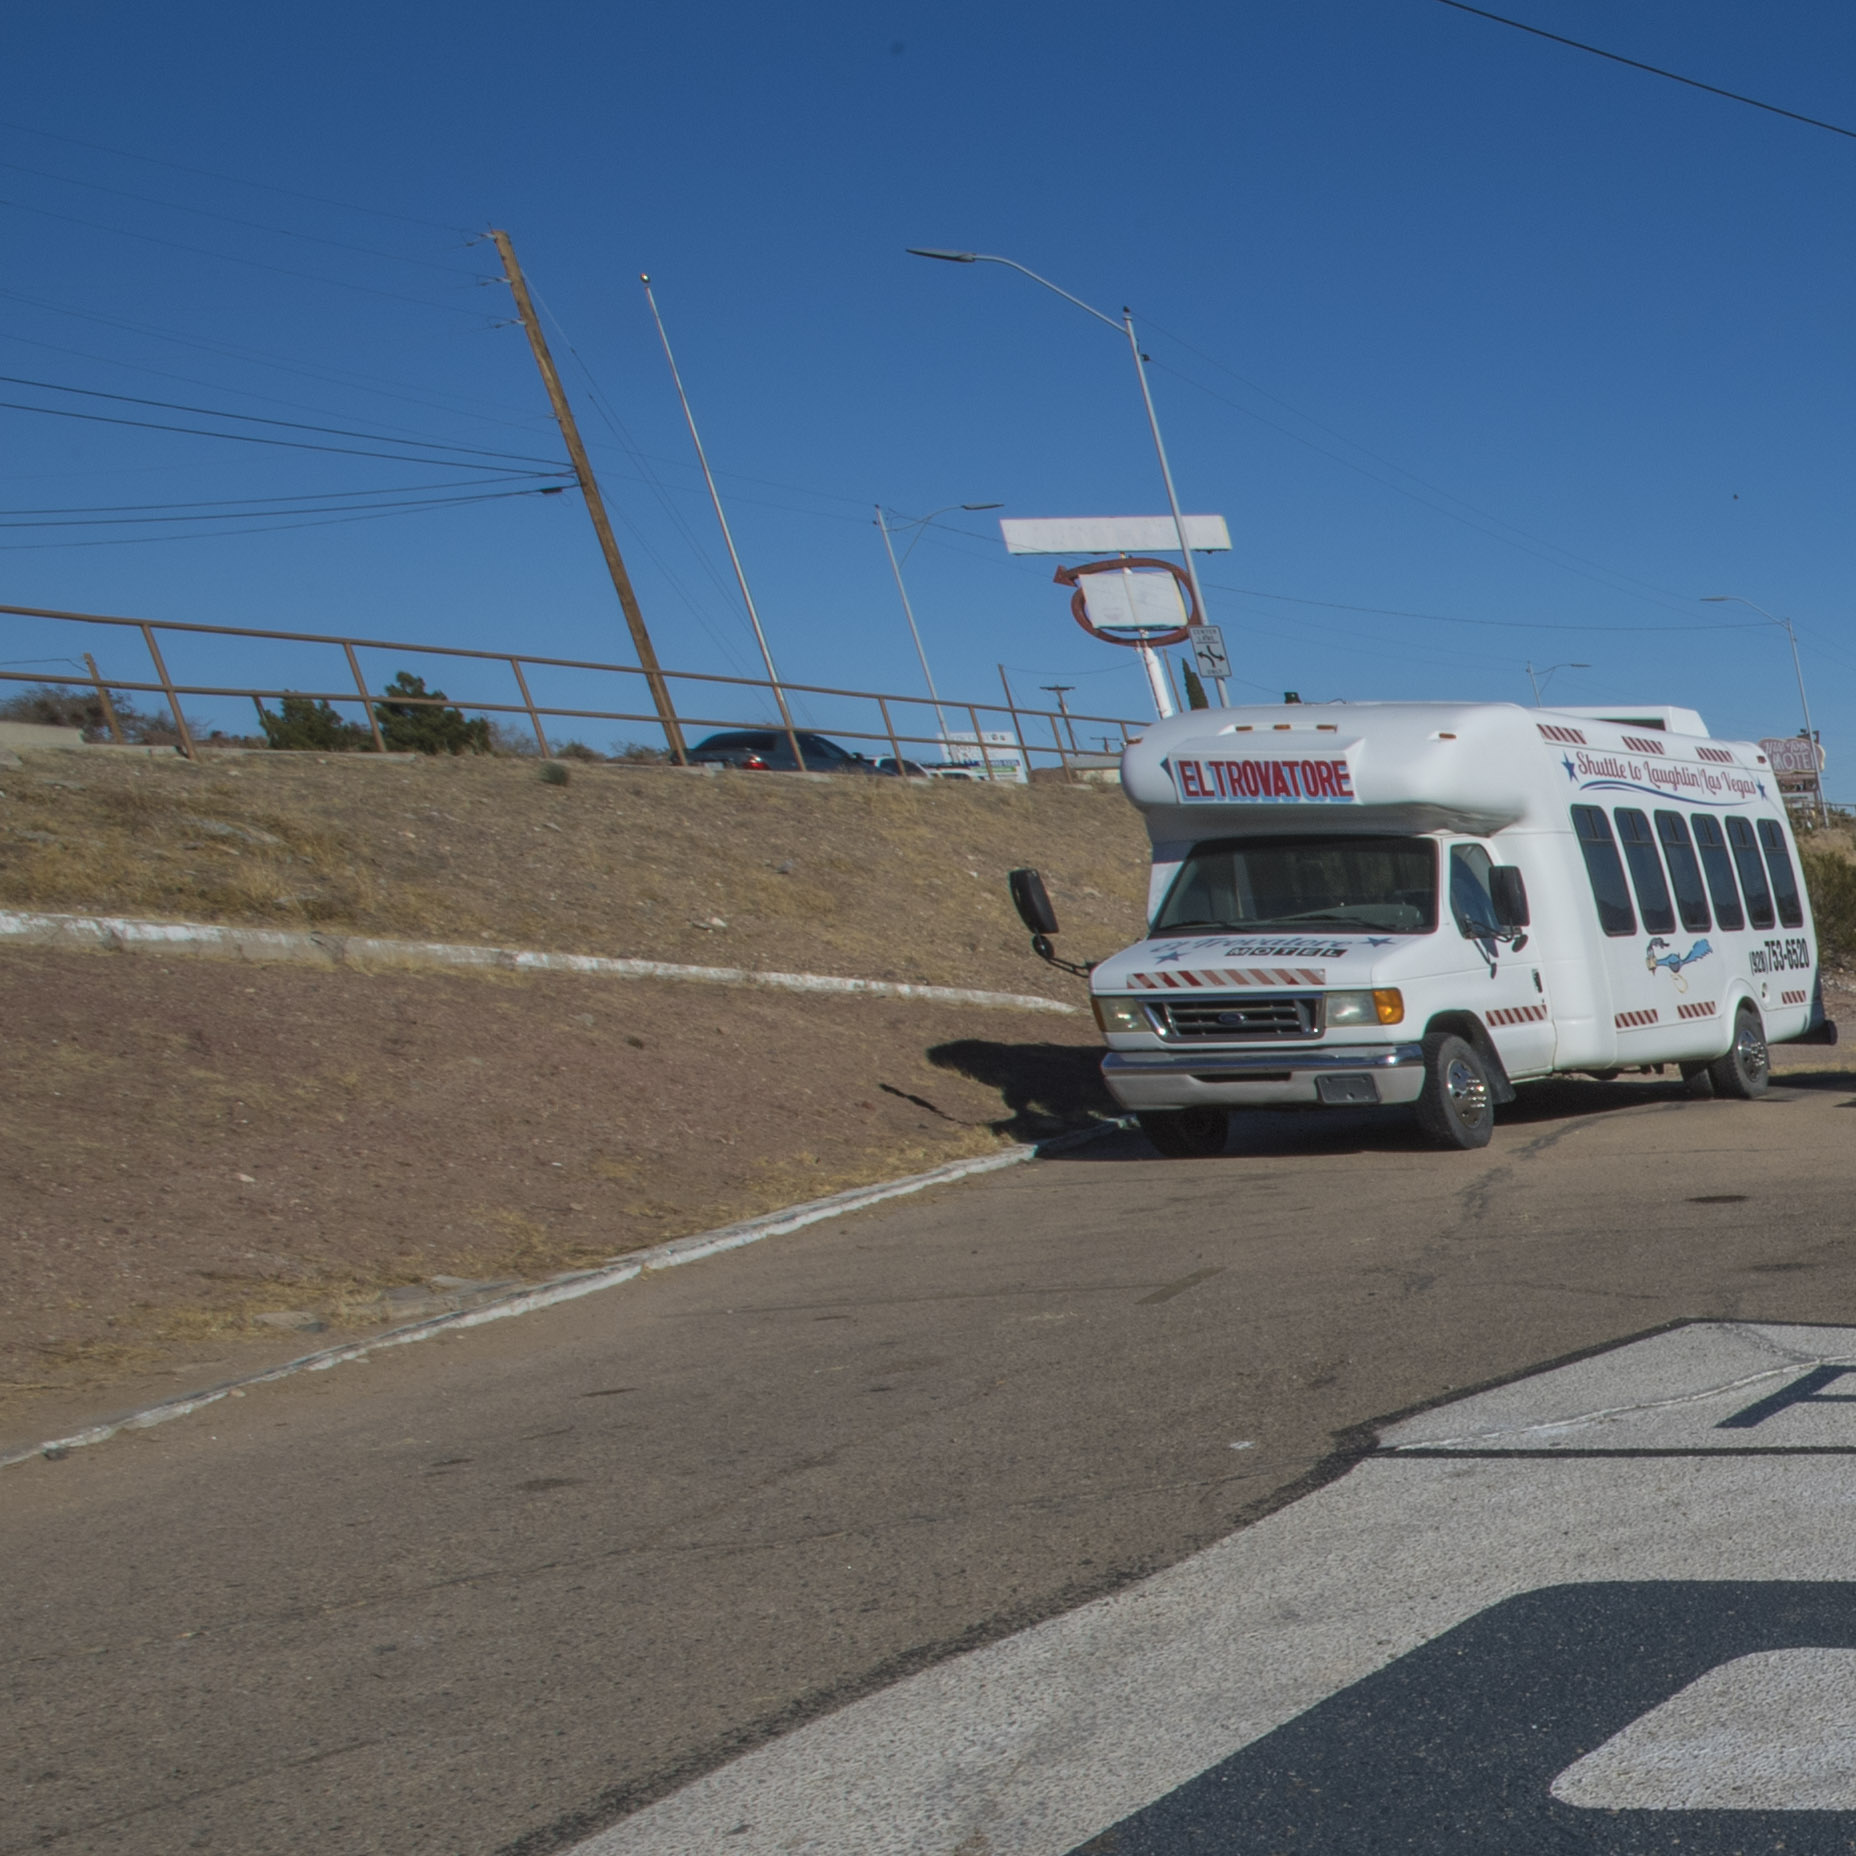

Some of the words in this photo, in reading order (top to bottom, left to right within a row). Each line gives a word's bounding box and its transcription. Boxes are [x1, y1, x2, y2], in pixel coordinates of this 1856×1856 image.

[1576, 751, 1627, 780] Shuttle
[1630, 763, 1641, 780] to
[1721, 770, 1756, 798] Vegas
[1225, 947, 1348, 958] MOTEL
[1765, 938, 1809, 973] 753-6520
